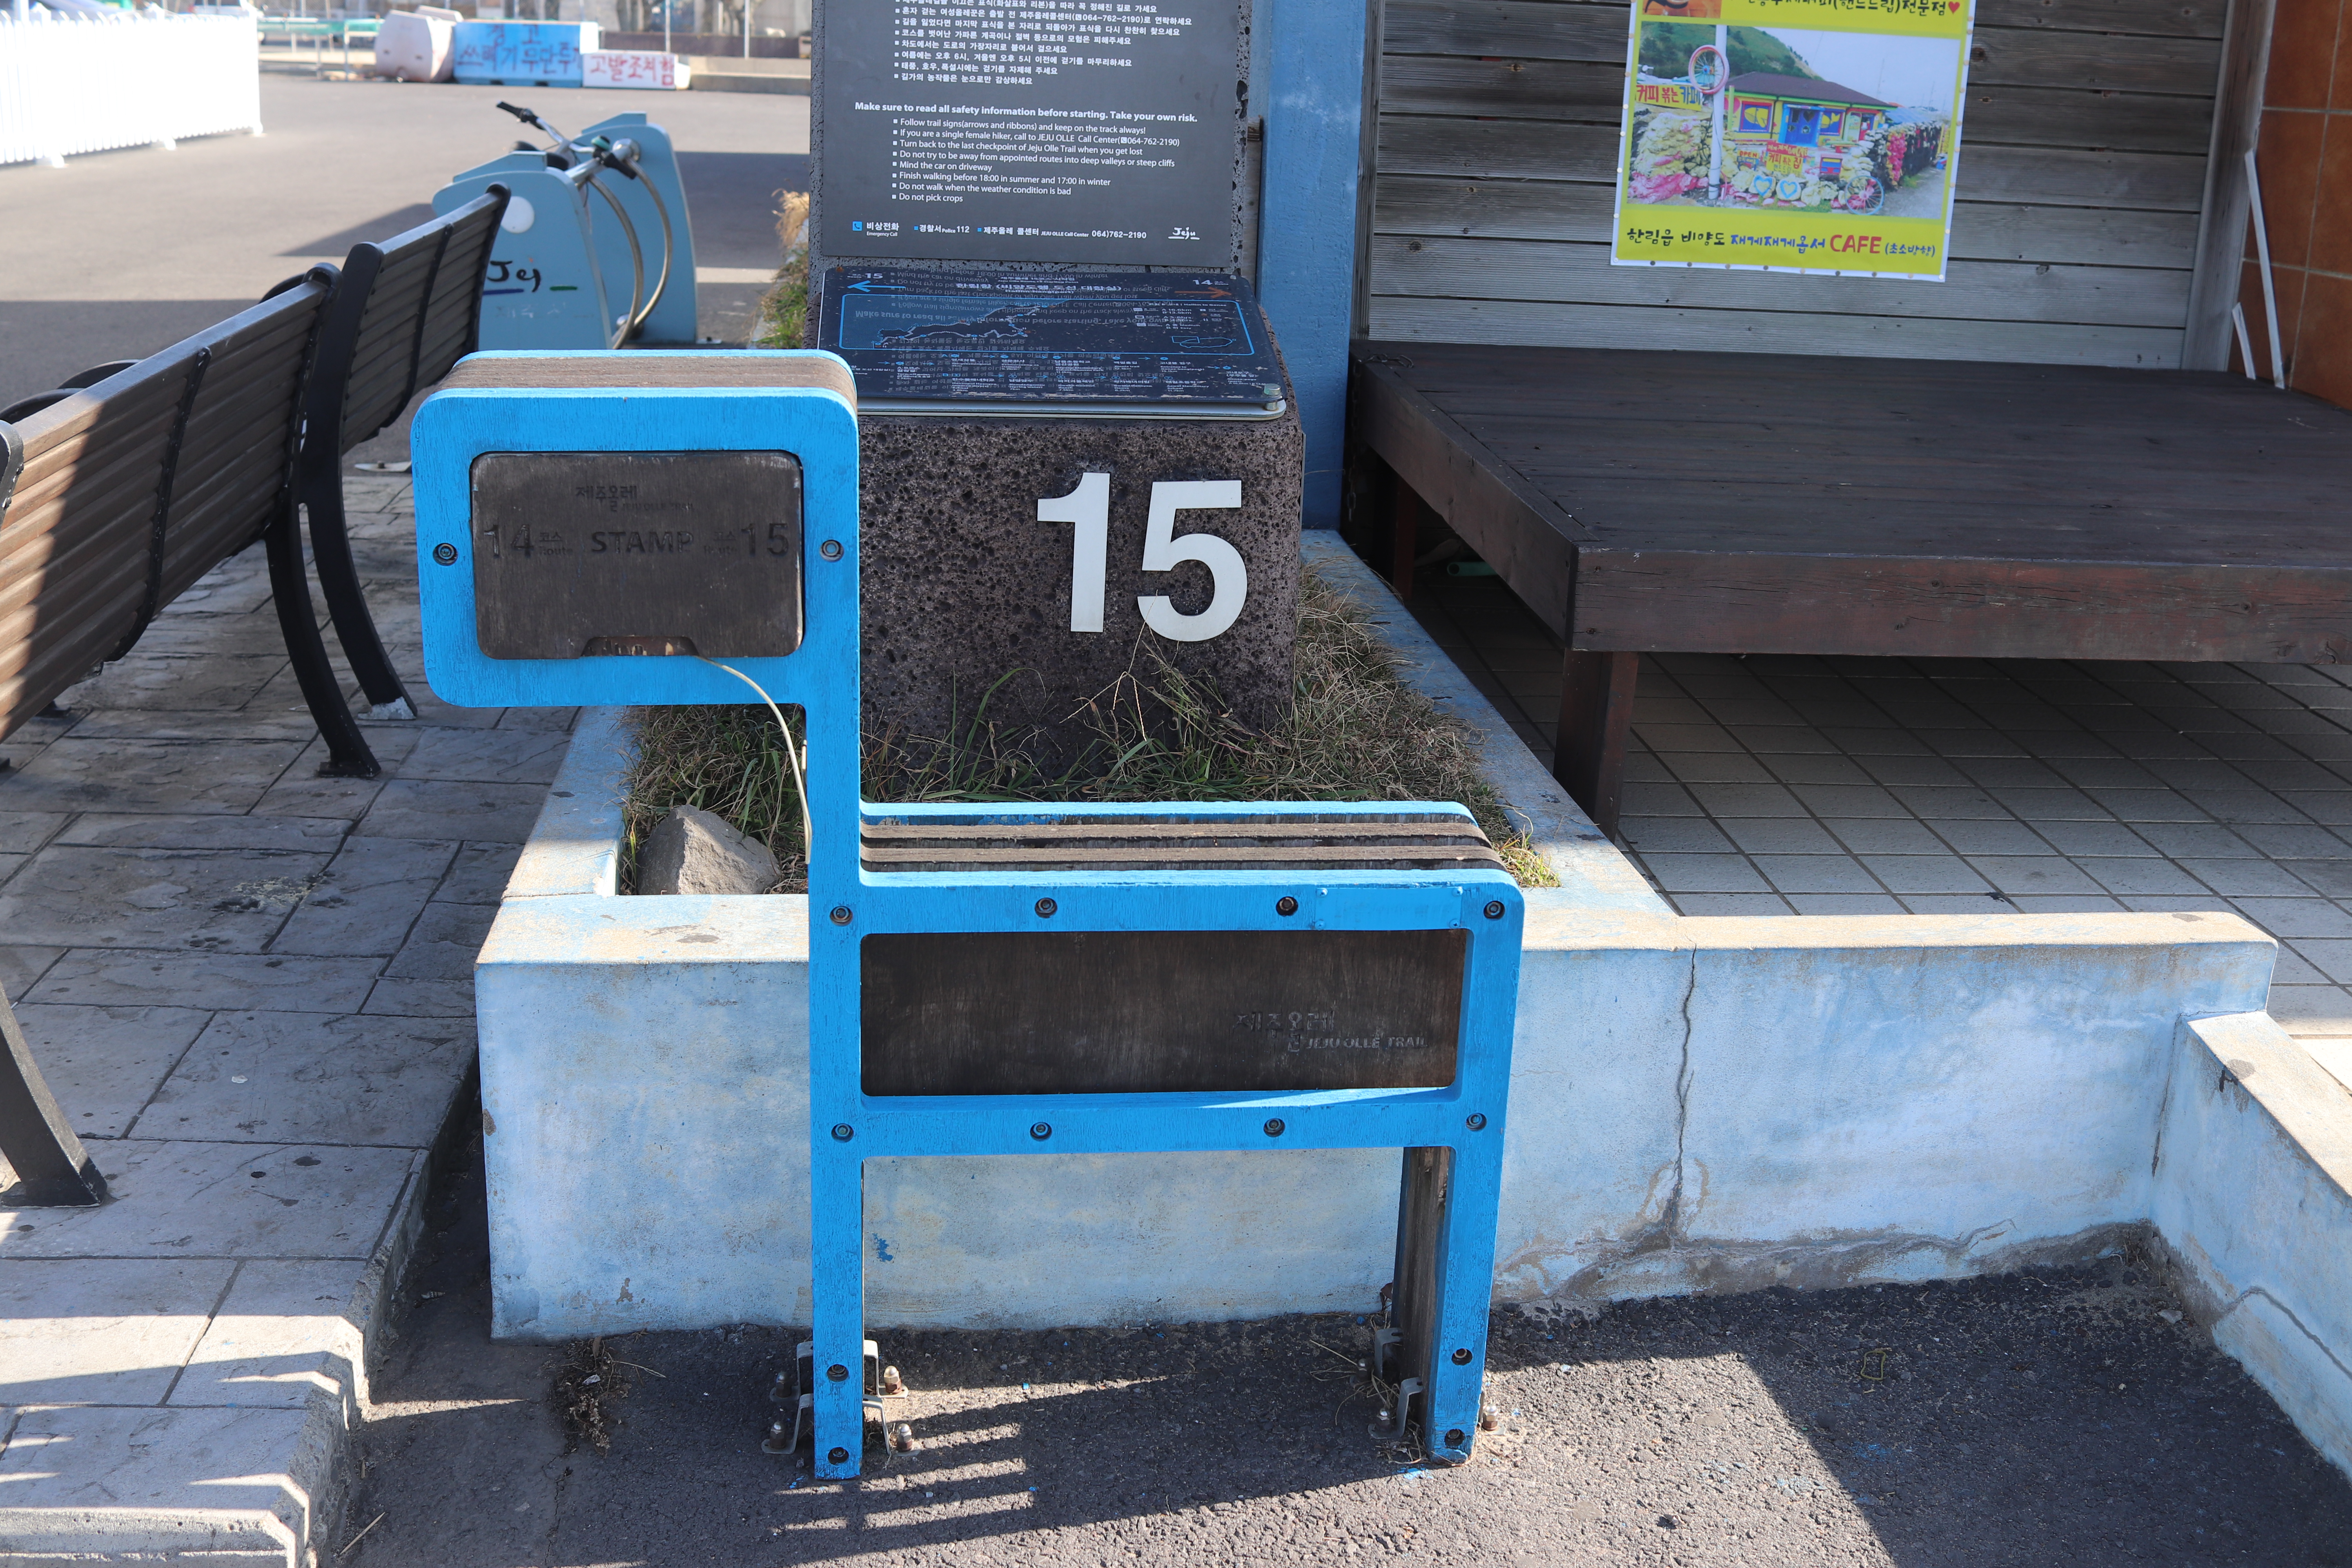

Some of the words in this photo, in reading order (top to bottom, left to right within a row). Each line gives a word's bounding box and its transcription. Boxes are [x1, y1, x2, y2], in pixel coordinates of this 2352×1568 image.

[902, 40, 940, 49] 차도에서는
[943, 42, 965, 50] 도로의
[969, 42, 1007, 51] 가장자리로
[1038, 45, 1067, 53] 걸으세요
[902, 51, 932, 59] 여름에는
[935, 52, 951, 60] 오후
[954, 53, 969, 61] 6시,
[974, 53, 996, 62] 겨울엔
[1035, 56, 1057, 64] 이전에
[1061, 56, 1083, 65] 걷기를
[1087, 58, 1132, 67] 마무리하세요
[901, 62, 919, 71] 태풍,
[983, 65, 1005, 73] 걷기를
[1009, 65, 1031, 74] 자제해
[1035, 67, 1058, 75] 주세요
[901, 73, 924, 81] 길가의
[927, 73, 958, 82] 농작물은
[961, 74, 991, 83] 눈으로만
[995, 76, 1033, 85] 감상하세요
[1636, 85, 1659, 102] 커피
[1662, 87, 1680, 103] 볶는
[1679, 86, 1700, 105] 카페
[855, 102, 880, 111] Make
[916, 104, 937, 113] read
[938, 104, 950, 113] all
[951, 105, 980, 116] safety
[981, 106, 1036, 116] information
[1038, 108, 1068, 117] before
[1070, 110, 1108, 120] starting.
[1110, 111, 1132, 120] Take
[1178, 113, 1198, 122] risk.
[900, 118, 926, 126] Follow
[943, 120, 989, 129] signs(arrows
[1006, 122, 1037, 131] ribbons)
[1054, 123, 1073, 133] keep
[1099, 125, 1118, 133] track
[1119, 126, 1146, 136] always!
[900, 129, 906, 137] If
[942, 130, 964, 140] single
[965, 131, 991, 139] female
[992, 131, 1013, 141] hiker,
[958, 162, 993, 173] driveway
[899, 171, 921, 180] Finish
[922, 172, 952, 182] walking
[953, 173, 978, 181] before
[926, 194, 942, 203] pick
[866, 221, 900, 231] 비상전화
[919, 224, 941, 232] 경찰서
[984, 227, 1013, 235] 제주올레
[1017, 227, 1039, 236] 콜센터
[1091, 230, 1147, 239] 064)762-2190
[1172, 226, 1196, 240] Jeju
[1627, 228, 1674, 246] 한림읍
[1681, 231, 1725, 246] 비양도
[1830, 234, 1882, 254] CAFE
[575, 485, 637, 512] 제주올레
[483, 524, 535, 558] 14
[591, 531, 694, 553] STAMP
[740, 523, 789, 557] 15
[539, 532, 563, 542] 코스
[1037, 472, 1248, 642] 15
[1233, 1010, 1335, 1052] 제주올레
[1306, 1036, 1341, 1049] JEJU
[1343, 1036, 1380, 1049] OLLE
[1387, 1036, 1428, 1049] TRAIL
